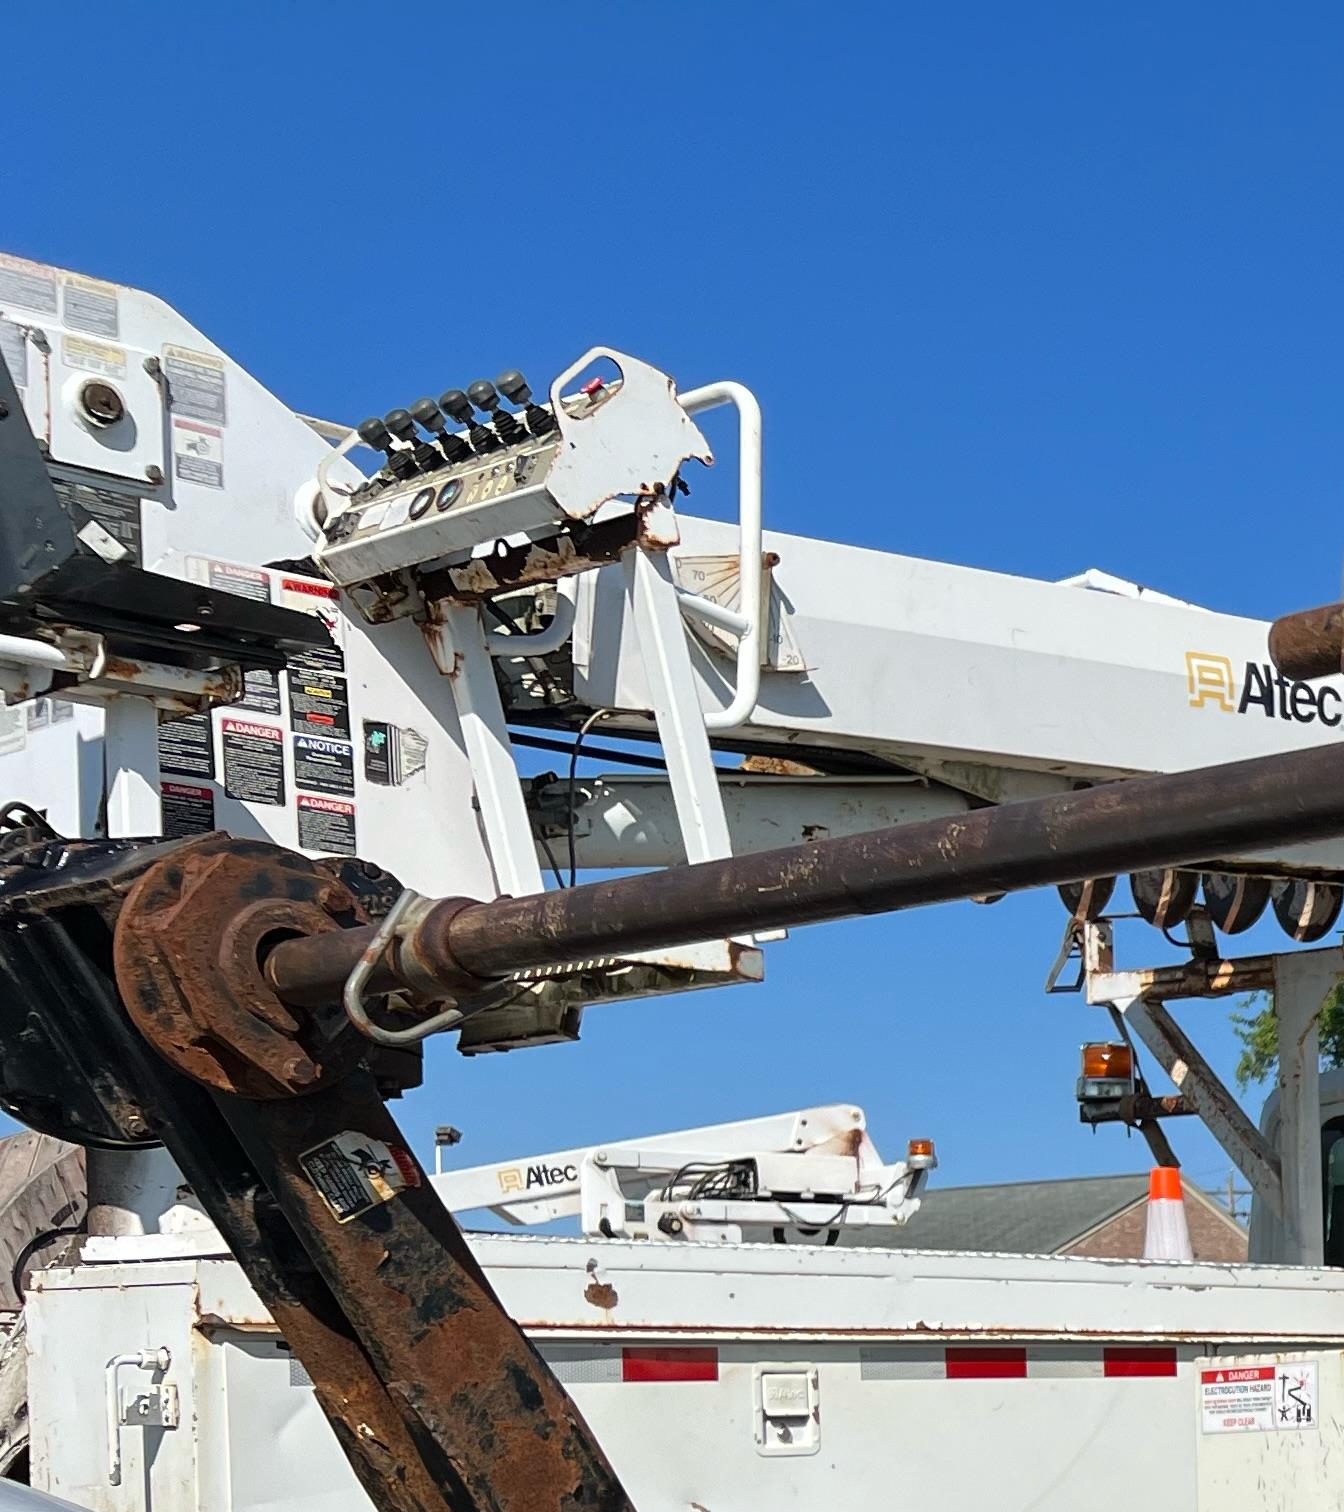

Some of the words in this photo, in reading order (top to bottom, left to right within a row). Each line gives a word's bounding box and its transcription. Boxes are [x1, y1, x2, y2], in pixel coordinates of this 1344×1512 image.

[692, 569, 706, 582] 70
[1238, 661, 1343, 728] Altec
[235, 723, 280, 738] DANGER
[308, 739, 351, 756] NOTICE
[310, 798, 353, 814] DANGER
[525, 1163, 578, 1190] Altec
[1228, 1370, 1260, 1381] DANGER
[1204, 1385, 1249, 1396] ELECTROCUTION
[1249, 1384, 1272, 1393] HAZARD
